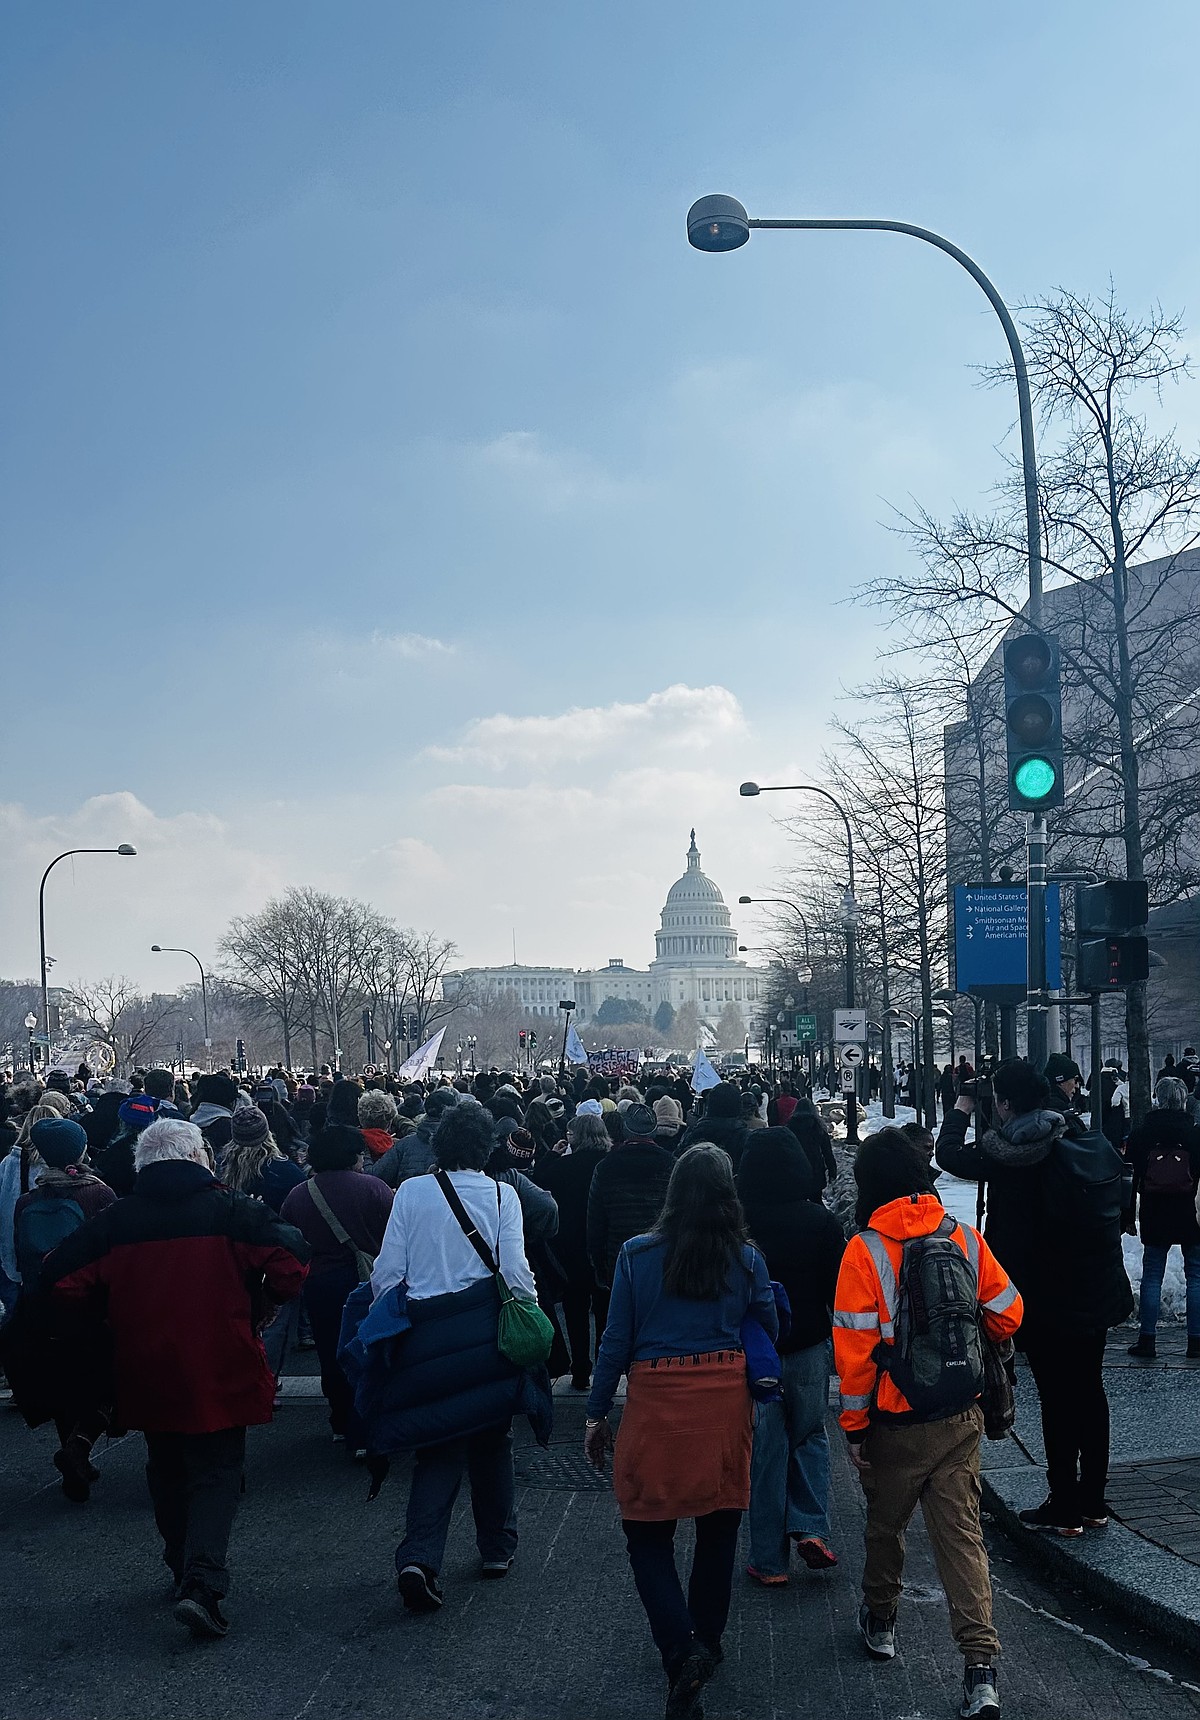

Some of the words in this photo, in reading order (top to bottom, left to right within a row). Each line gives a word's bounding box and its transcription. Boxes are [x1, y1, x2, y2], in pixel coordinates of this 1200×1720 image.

[974, 893, 997, 901] United
[998, 893, 1019, 901] States
[974, 905, 1003, 913] National
[1004, 904, 1028, 913] Gallery
[974, 916, 1017, 925] Smithsonian
[650, 1352, 735, 1369] WYOMING
